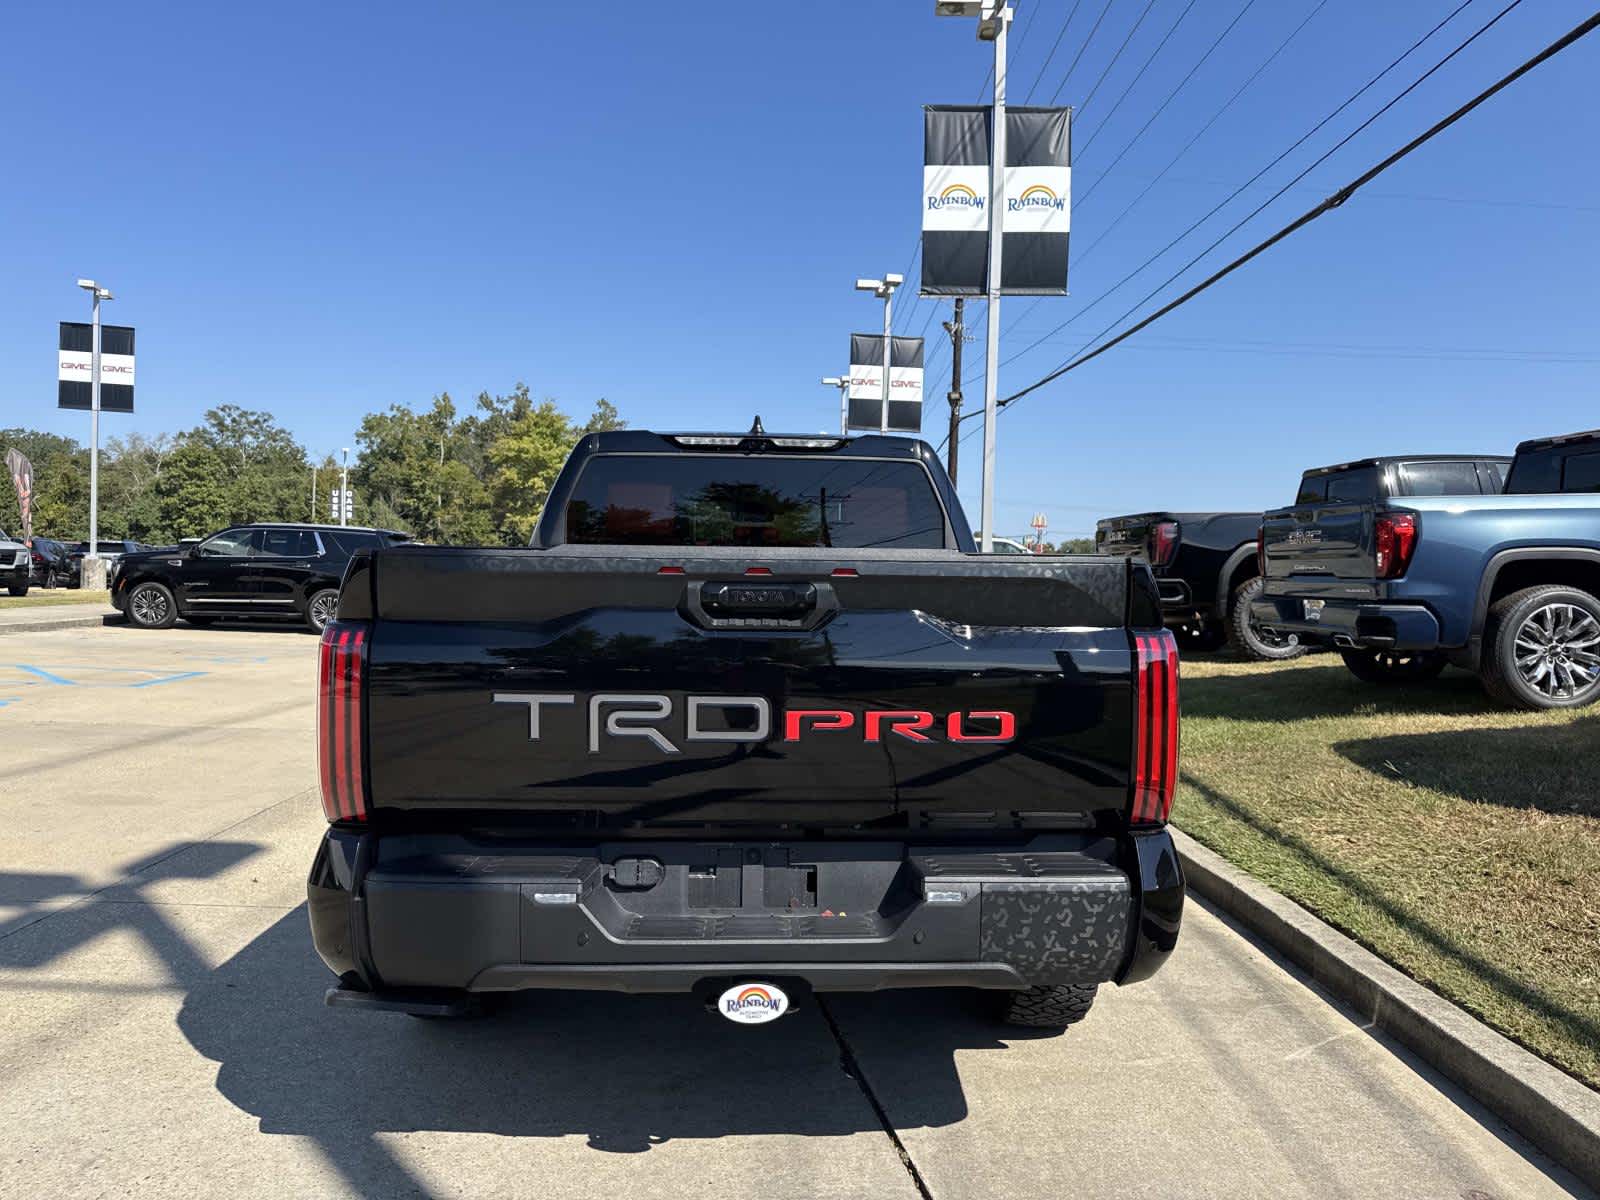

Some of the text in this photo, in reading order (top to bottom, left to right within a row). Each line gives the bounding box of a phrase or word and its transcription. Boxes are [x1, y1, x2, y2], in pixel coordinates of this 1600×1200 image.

[927, 195, 986, 210] RAINBOW
[1007, 197, 1066, 212] RAINBOW
[61, 362, 92, 371] GMC
[102, 365, 133, 374] GMC
[850, 378, 881, 387] GMC
[890, 380, 921, 389] GMC
[733, 590, 785, 602] TOYOTA
[493, 693, 1016, 754] TRD PRO
[726, 999, 781, 1012] RAINBOW
